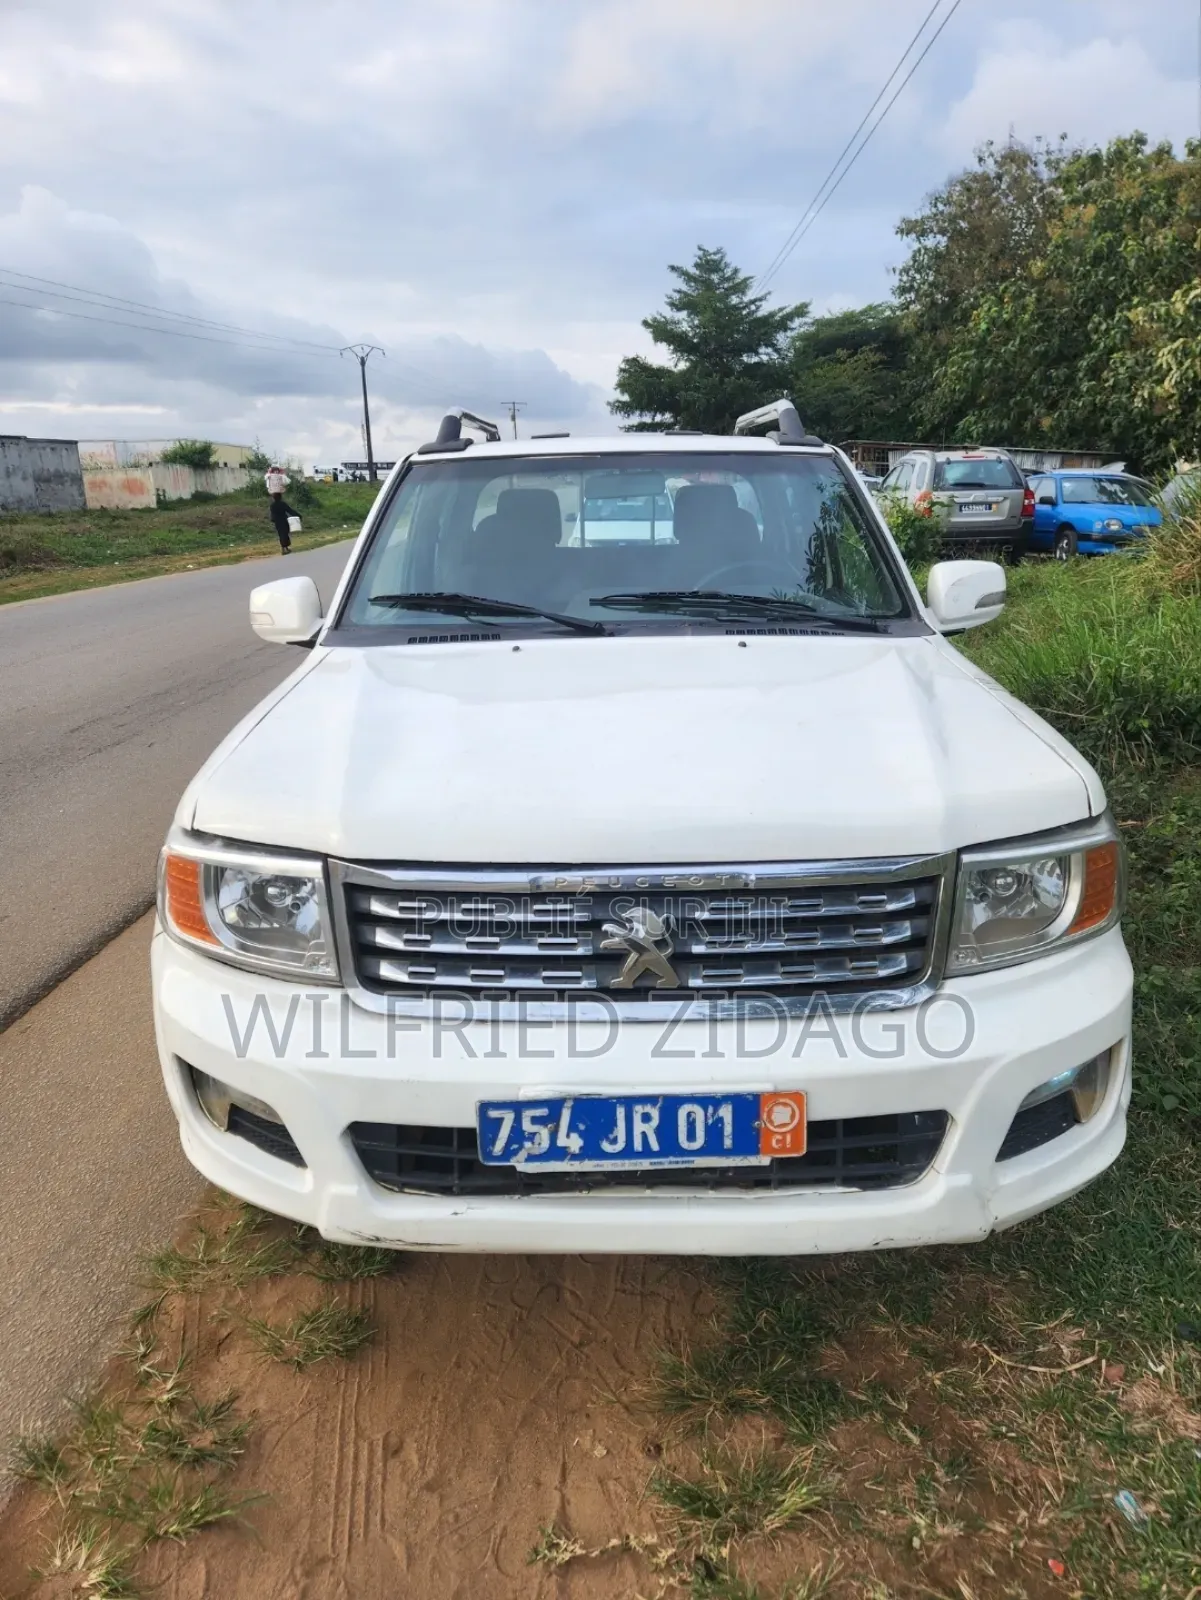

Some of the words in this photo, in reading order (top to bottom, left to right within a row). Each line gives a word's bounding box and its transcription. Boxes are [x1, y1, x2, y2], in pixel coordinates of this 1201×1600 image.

[554, 875, 733, 888] PEUGEOT
[487, 1098, 584, 1157] 754
[599, 1102, 661, 1154] JR
[676, 1102, 734, 1151] 01
[771, 1132, 792, 1149] CI
